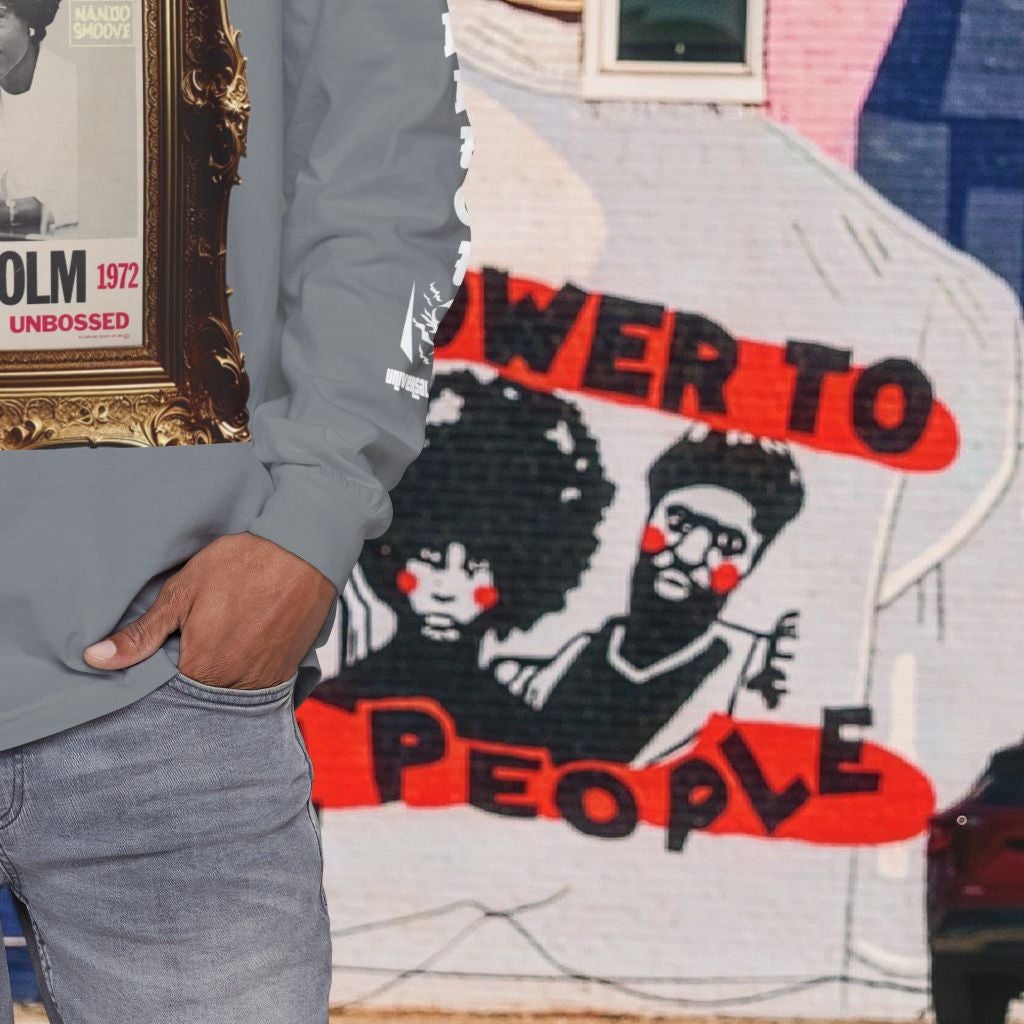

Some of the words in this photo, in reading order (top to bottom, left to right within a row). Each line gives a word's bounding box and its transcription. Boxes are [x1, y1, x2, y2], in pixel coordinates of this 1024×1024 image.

[73, 22, 131, 39] SMOOVE
[97, 262, 139, 290] 1972
[9, 312, 130, 334] UNBOSSED
[785, 340, 932, 454] TO
[370, 707, 880, 852] PEOPLE
